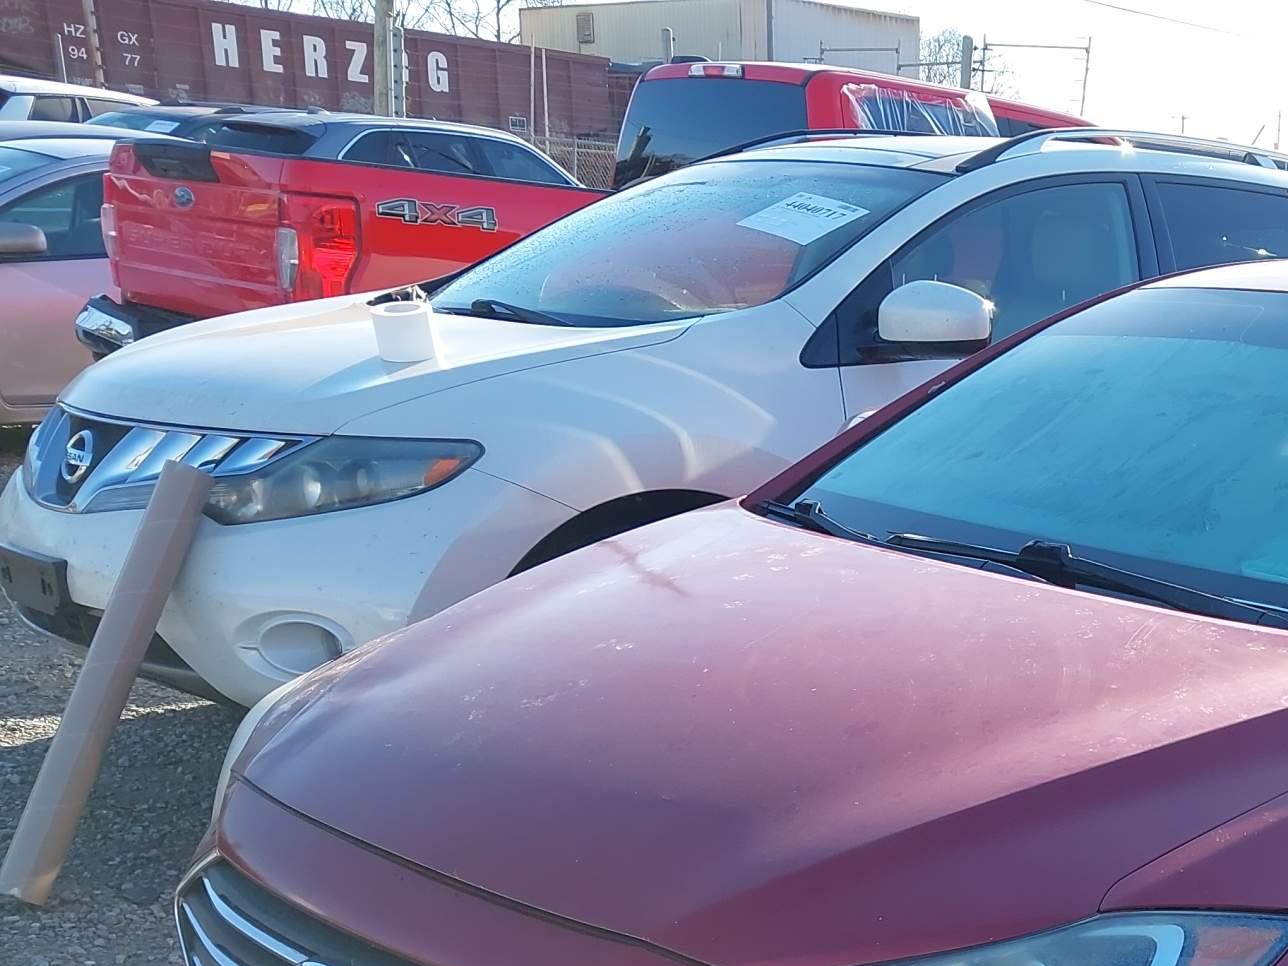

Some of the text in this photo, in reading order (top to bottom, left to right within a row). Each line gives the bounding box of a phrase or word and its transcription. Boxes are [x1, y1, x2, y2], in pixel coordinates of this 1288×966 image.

[63, 23, 140, 46] HZ GX
[68, 46, 141, 67] 94 77
